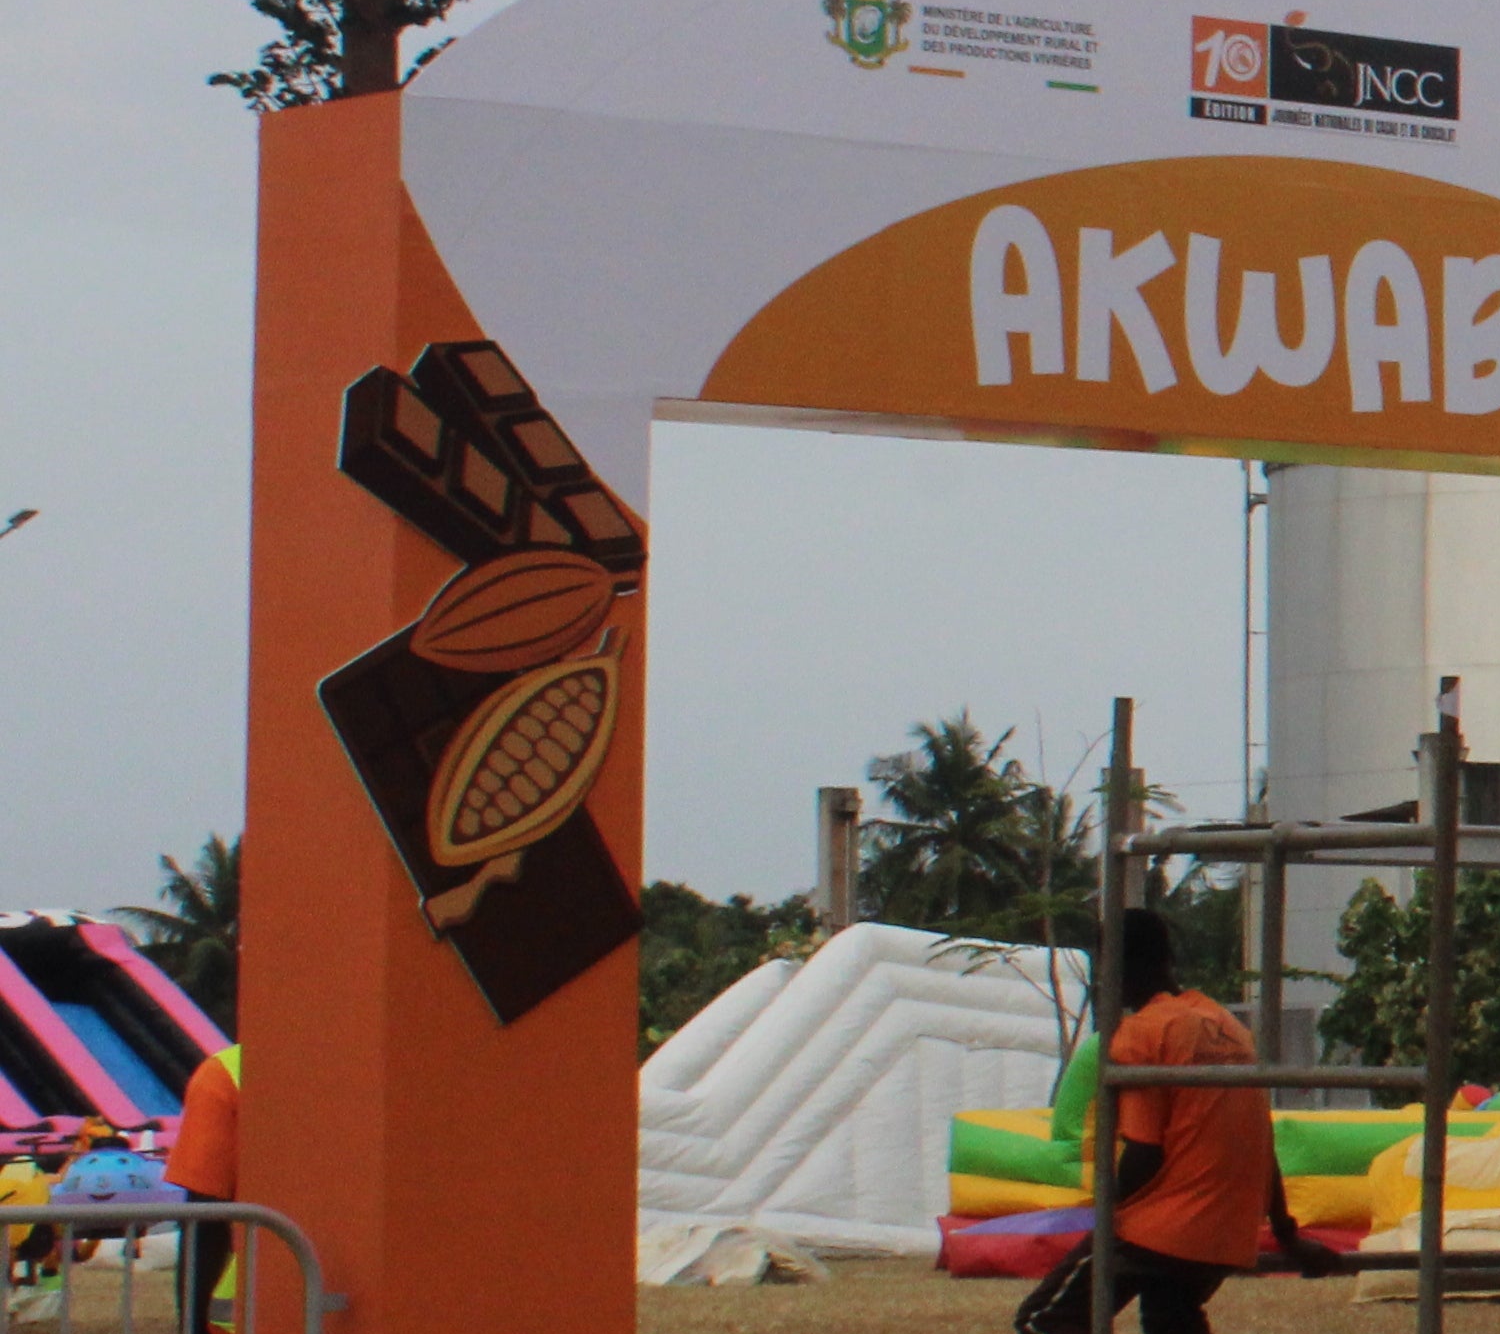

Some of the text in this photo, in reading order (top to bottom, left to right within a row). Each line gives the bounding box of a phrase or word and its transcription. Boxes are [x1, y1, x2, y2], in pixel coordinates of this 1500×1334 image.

[987, 12, 1002, 25] DE
[922, 22, 940, 35] DU
[1044, 36, 1081, 51] RURAL
[1085, 41, 1099, 53] ET
[922, 40, 946, 53] DES
[949, 42, 1031, 63] PRODUCTIONS
[1355, 62, 1445, 108] JNCC
